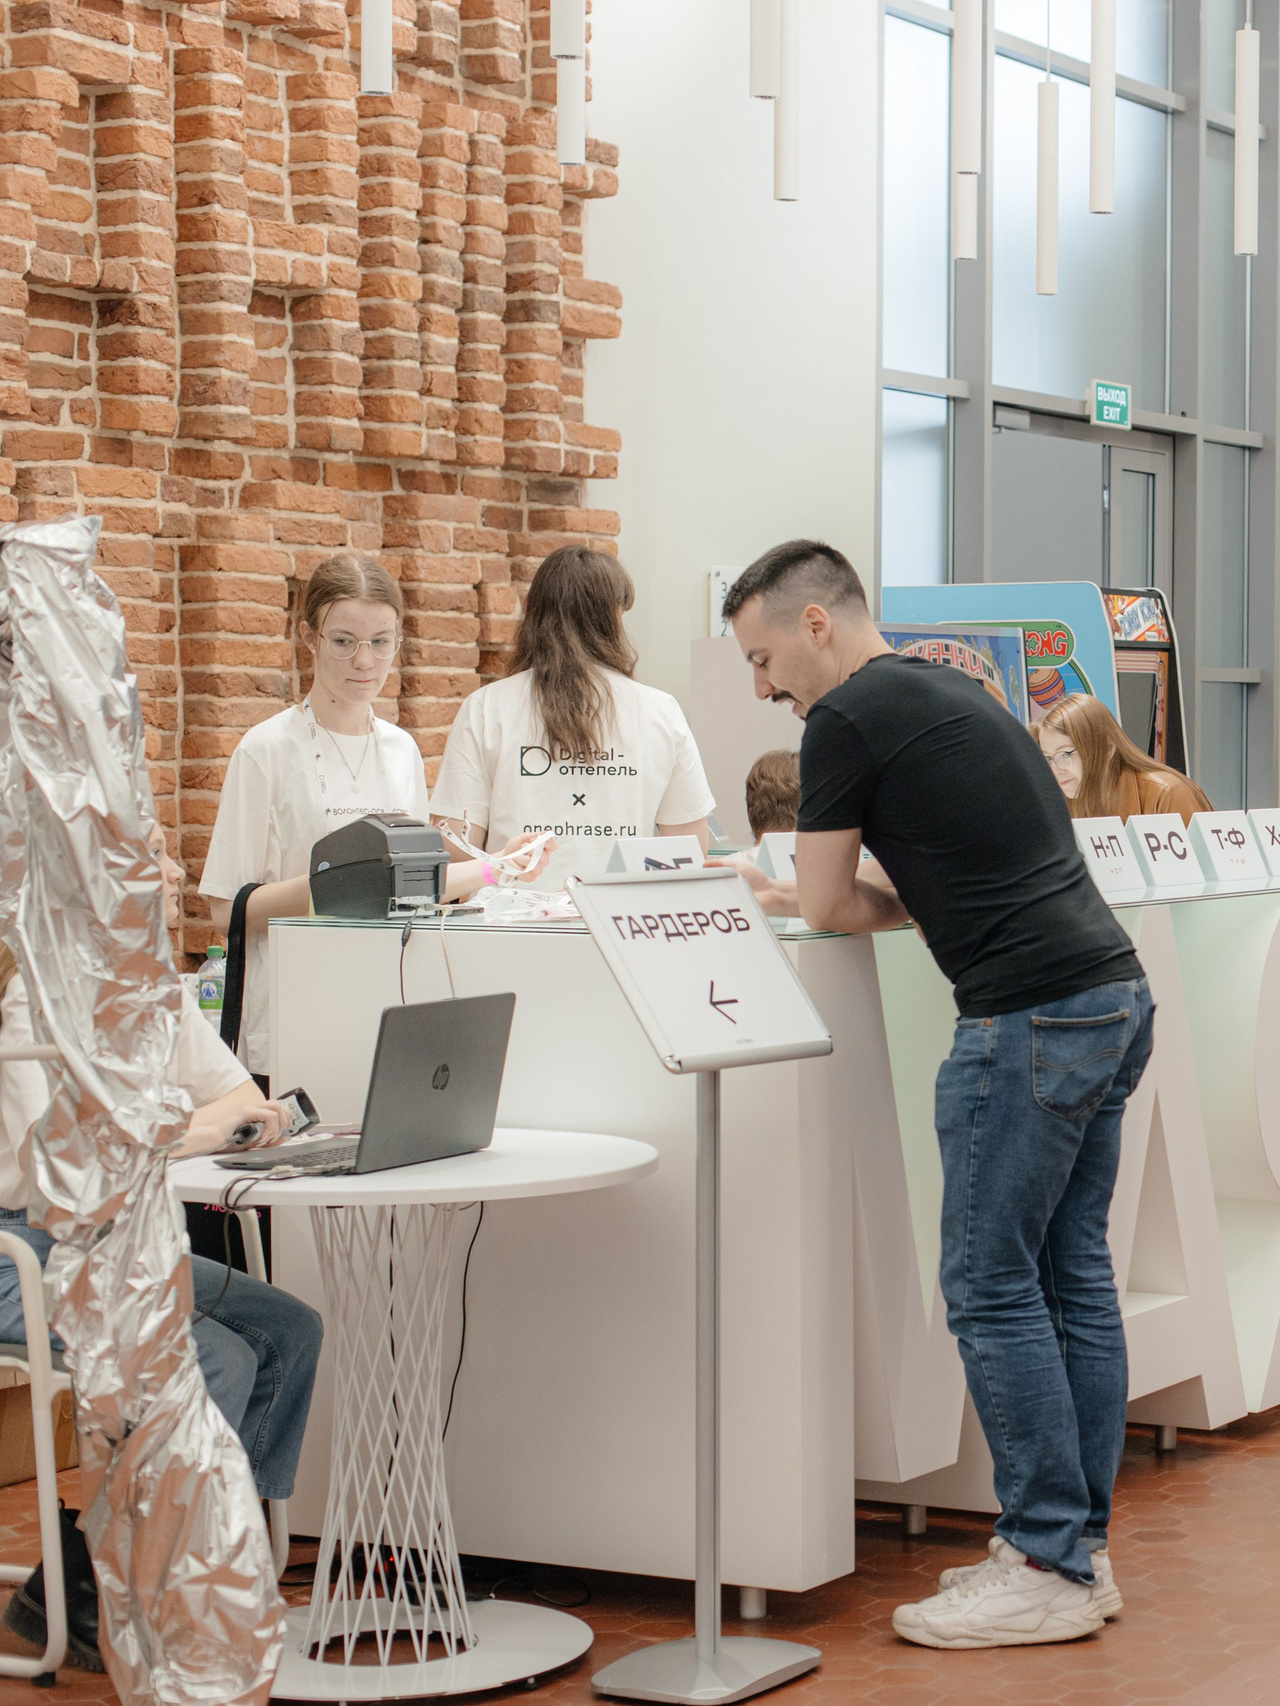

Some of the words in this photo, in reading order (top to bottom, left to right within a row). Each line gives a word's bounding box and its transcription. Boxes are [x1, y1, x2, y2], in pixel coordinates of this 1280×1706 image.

[1097, 386, 1127, 407] ВЫХОД
[1103, 405, 1121, 421] EXIT
[1024, 630, 1068, 657] ONG
[559, 765, 638, 776] оттепель
[523, 821, 637, 838] onephrase.ru
[1211, 828, 1245, 850] Т-Ф
[1090, 834, 1124, 858] Н-П
[1144, 831, 1187, 861] Р-С
[611, 908, 750, 942] ГАРДЕРОБ
